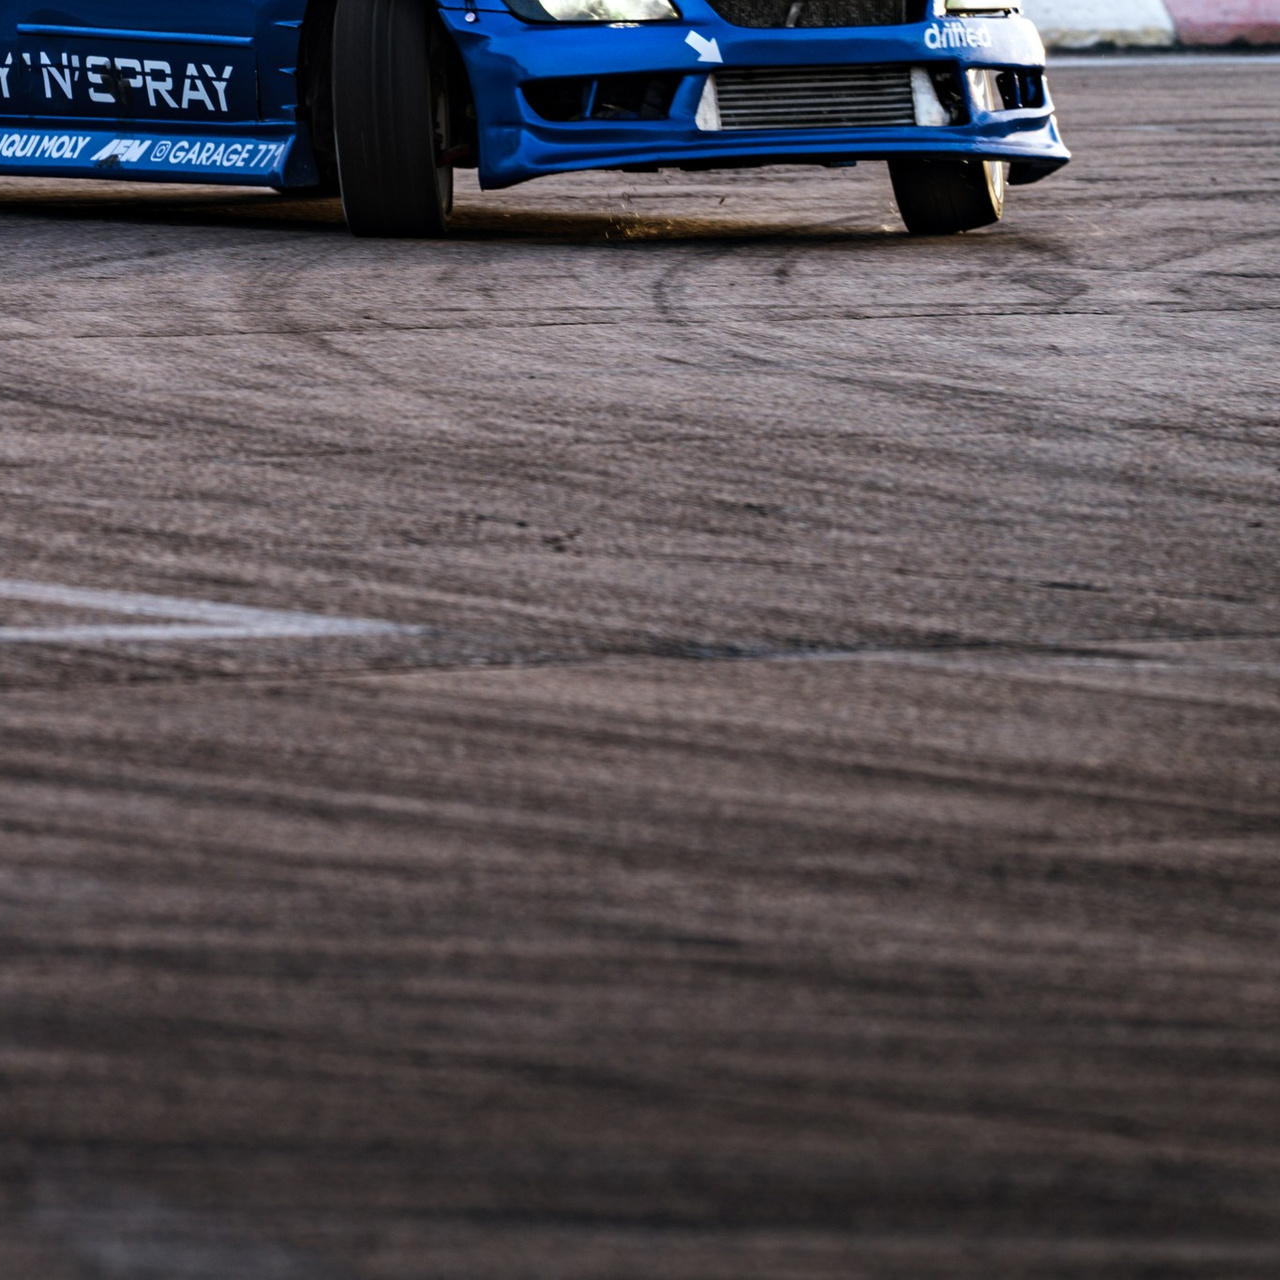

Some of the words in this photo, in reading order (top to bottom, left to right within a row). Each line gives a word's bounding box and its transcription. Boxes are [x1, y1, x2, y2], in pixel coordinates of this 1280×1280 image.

[924, 22, 992, 50] drifted
[35, 135, 91, 159] MOLY
[170, 141, 254, 167] GARAGE
